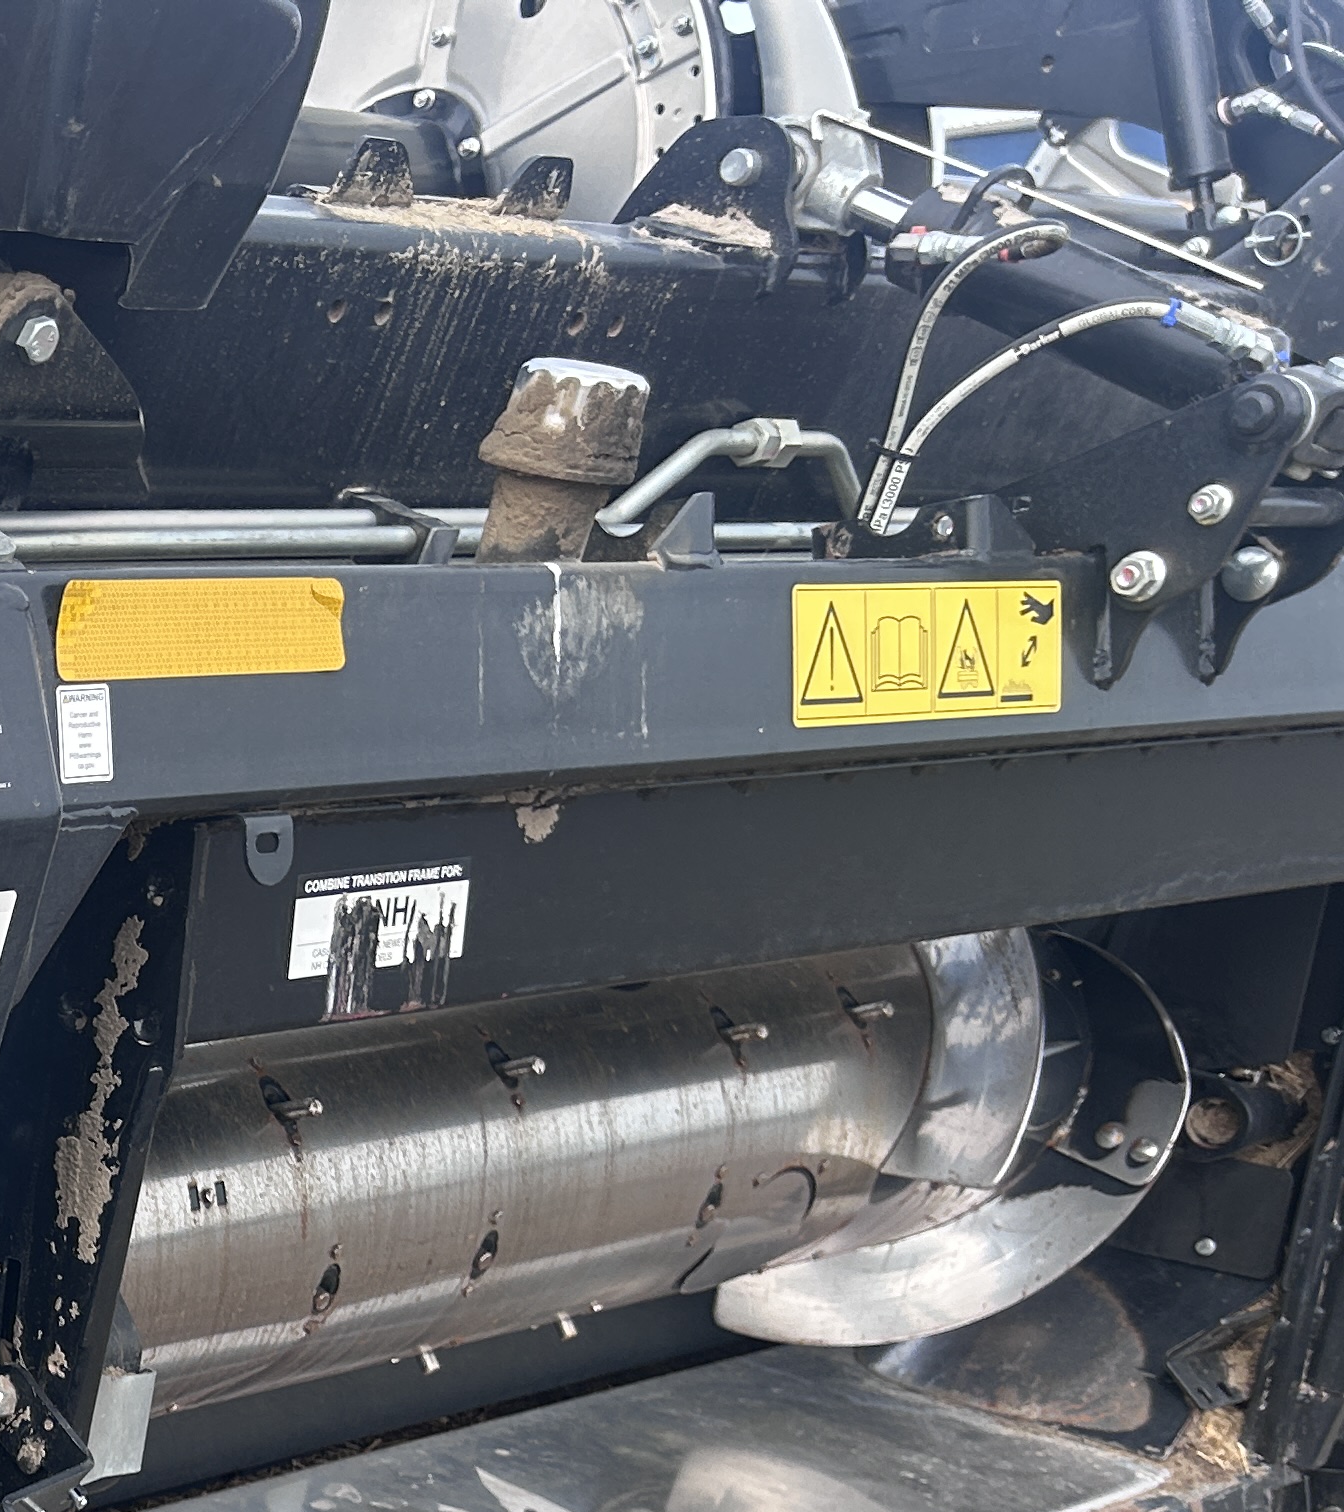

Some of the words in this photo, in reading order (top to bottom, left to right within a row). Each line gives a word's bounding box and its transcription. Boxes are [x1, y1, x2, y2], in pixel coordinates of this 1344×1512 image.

[304, 878, 350, 893] COMBINE
[352, 871, 407, 889] TRANSITION
[408, 867, 440, 882] FRAME
